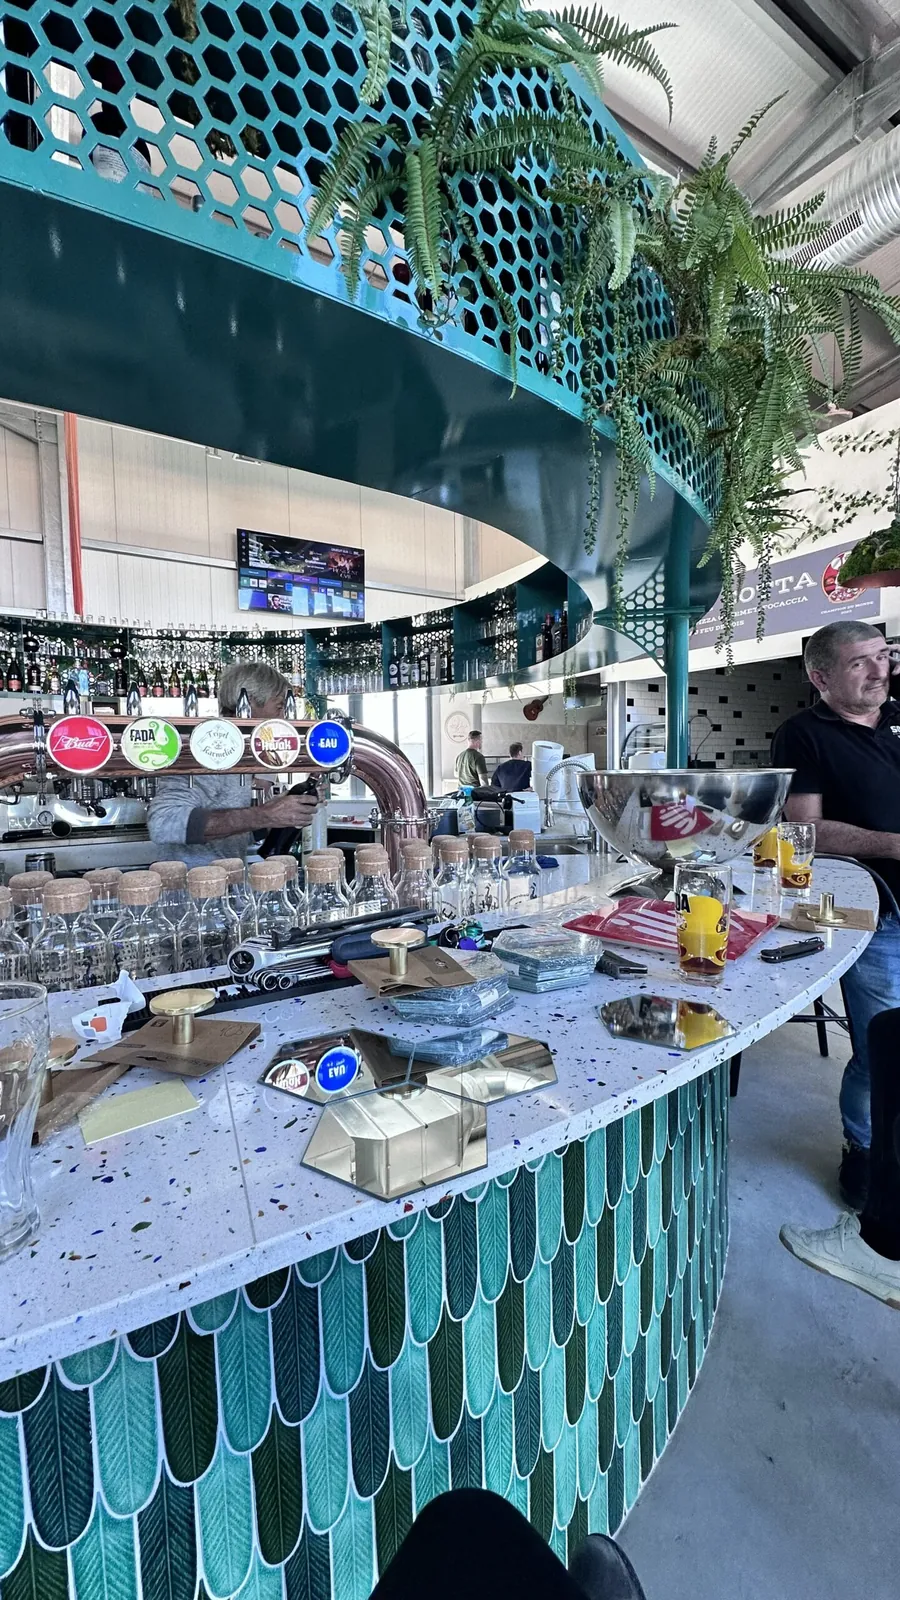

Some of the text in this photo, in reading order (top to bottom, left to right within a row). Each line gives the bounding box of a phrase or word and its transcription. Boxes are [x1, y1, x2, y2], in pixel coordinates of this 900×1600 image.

[130, 728, 156, 742] FADA
[62, 736, 99, 749] Bud
[320, 738, 338, 748] EAU
